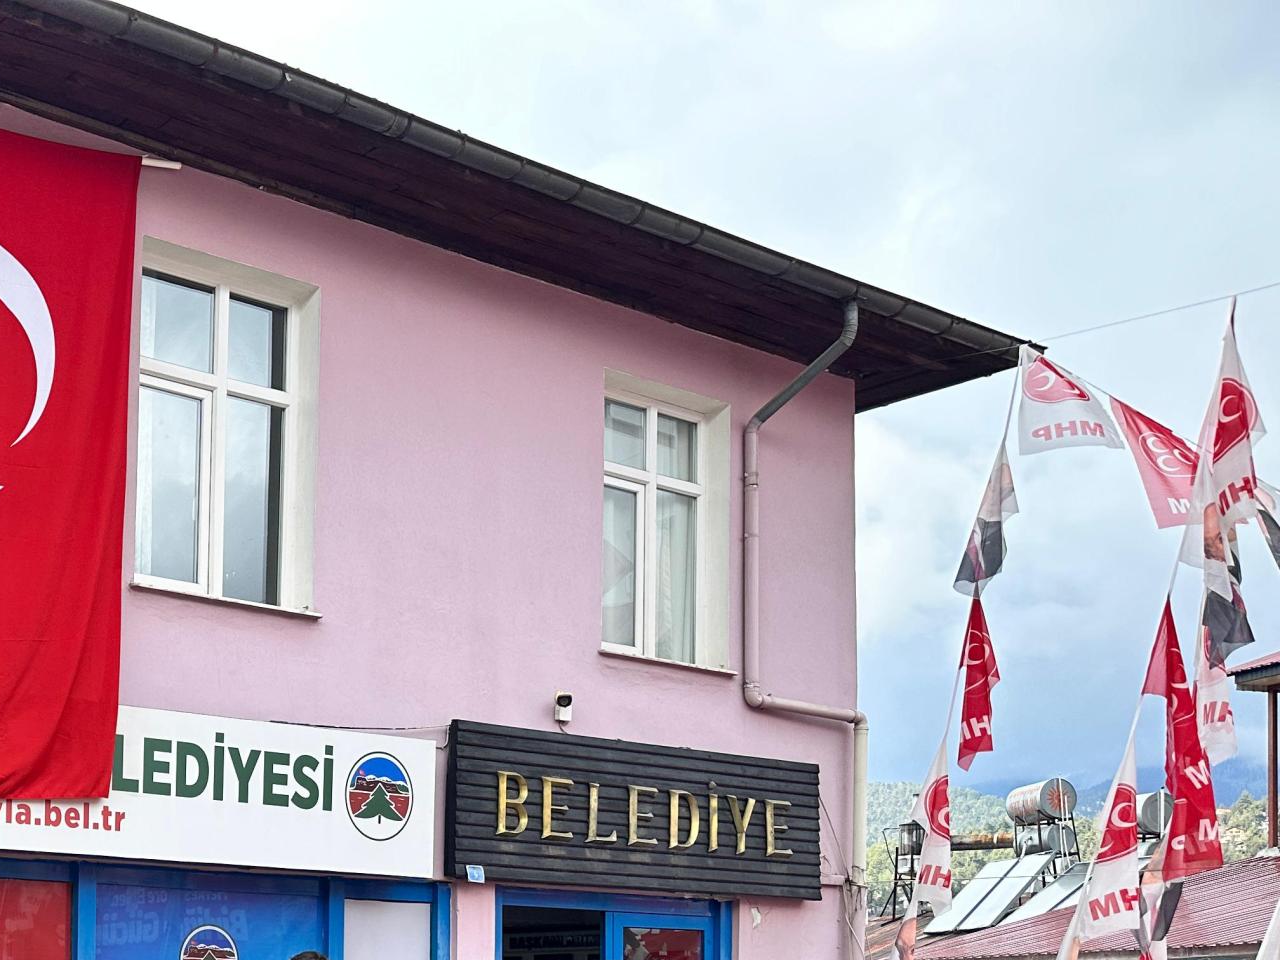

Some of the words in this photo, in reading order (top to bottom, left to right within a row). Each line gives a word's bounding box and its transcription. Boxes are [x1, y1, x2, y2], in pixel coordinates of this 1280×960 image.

[111, 732, 334, 812] LEDİYESİ
[495, 771, 794, 857] BELEDİYE
[1088, 887, 1141, 921] MH
